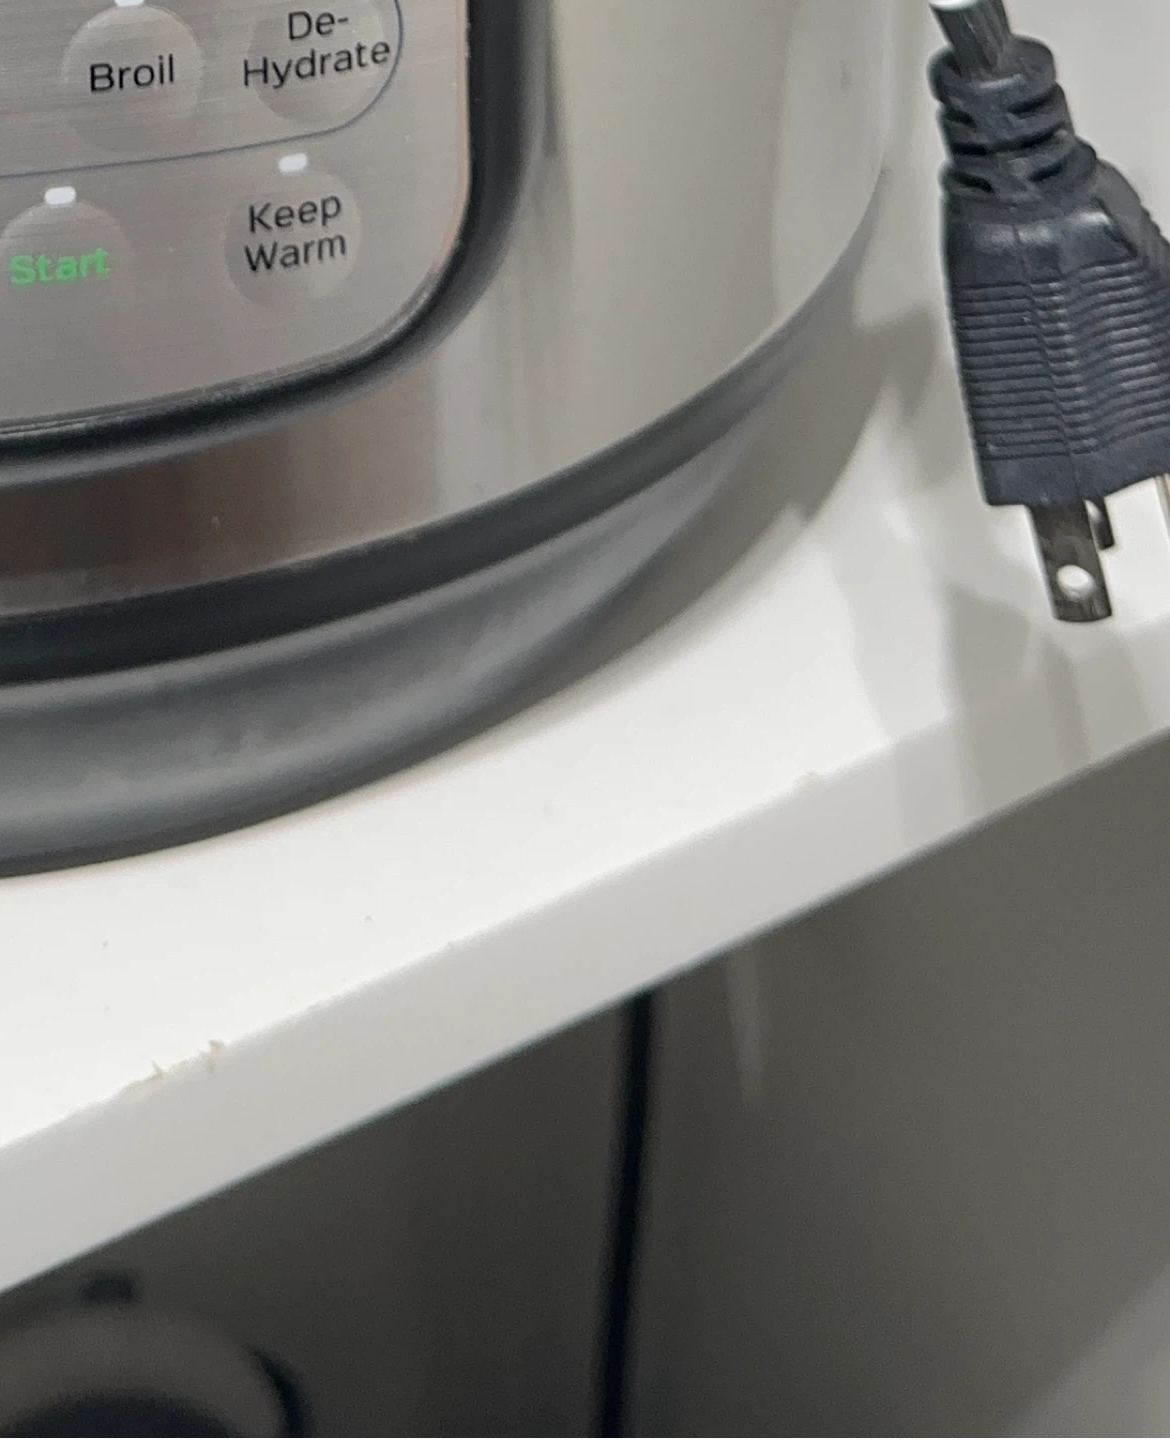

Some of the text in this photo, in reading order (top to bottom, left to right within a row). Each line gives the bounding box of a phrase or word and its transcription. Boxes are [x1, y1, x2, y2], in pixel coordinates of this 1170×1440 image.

[289, 11, 348, 40] De-
[90, 54, 174, 92] Broil
[243, 39, 391, 88] Hydrate
[249, 196, 341, 233] Keep
[10, 248, 111, 287] Start
[244, 233, 347, 273] Warm
